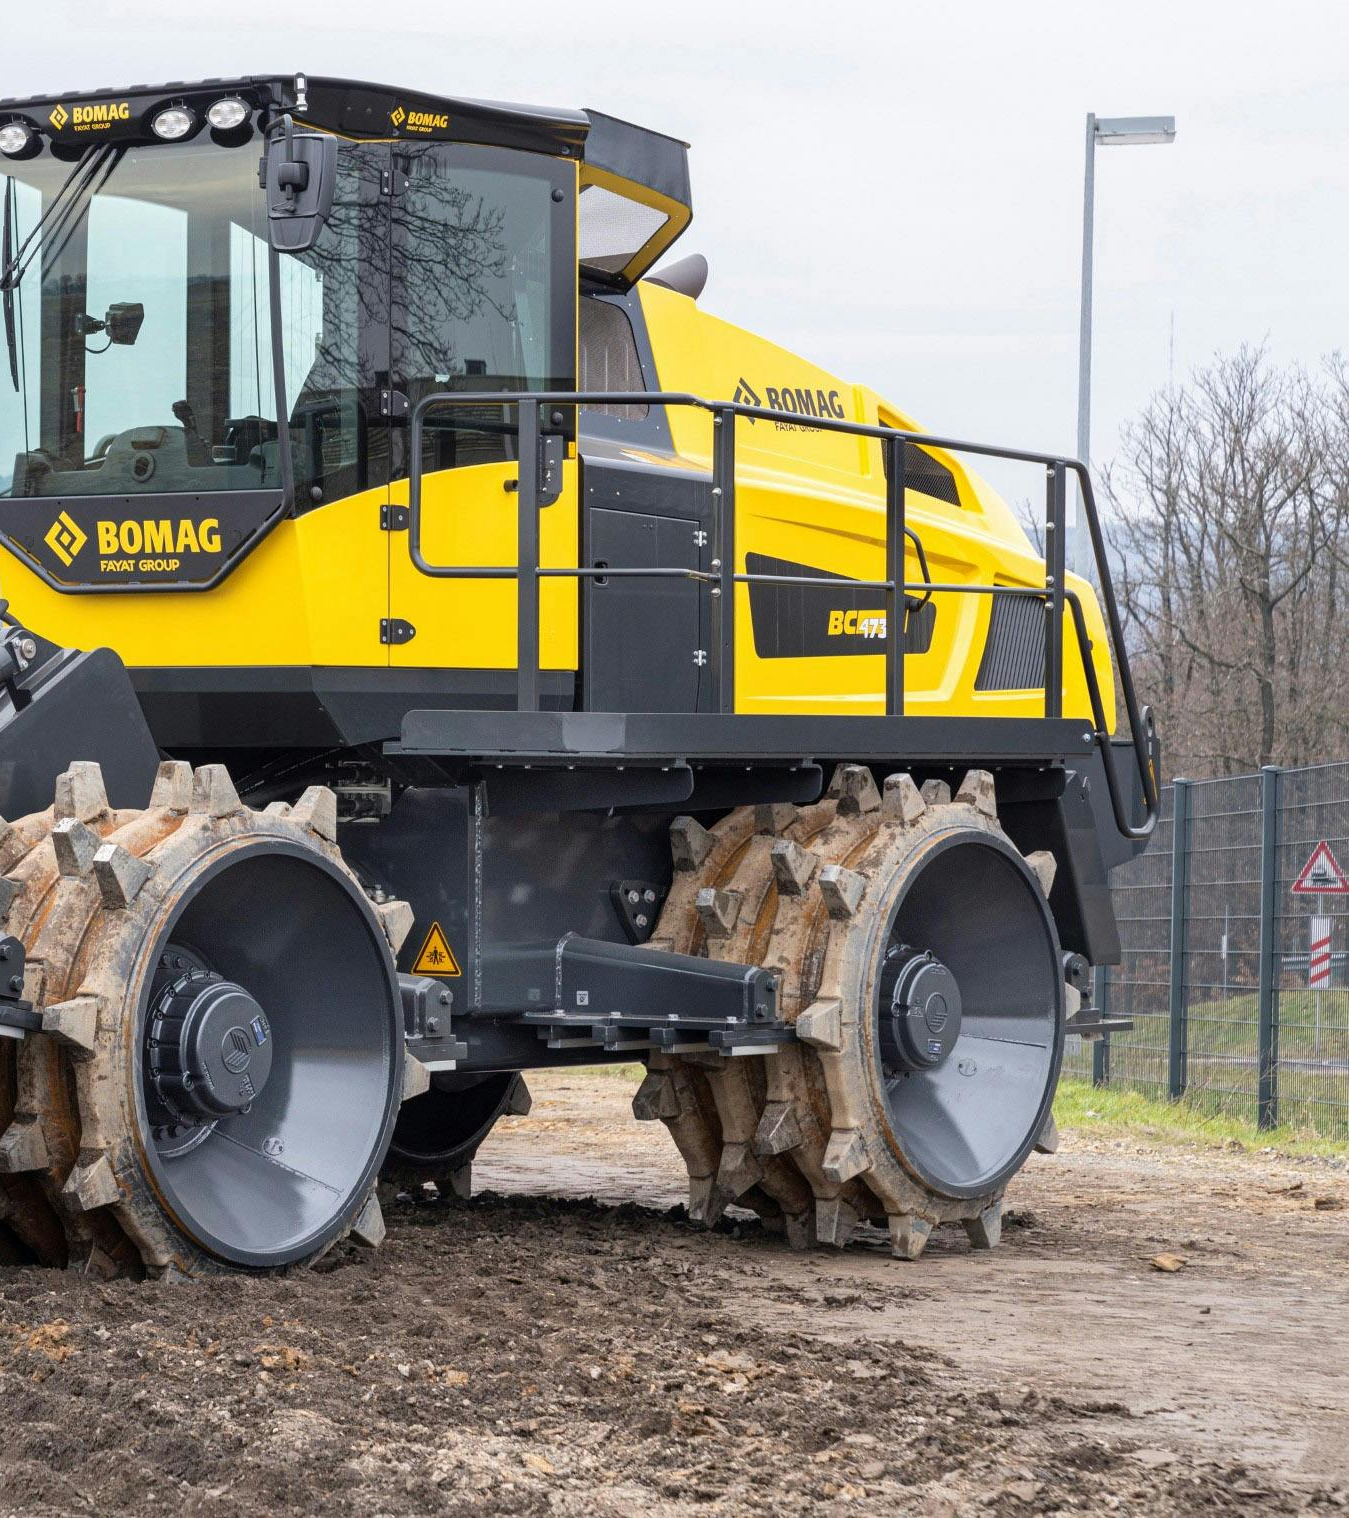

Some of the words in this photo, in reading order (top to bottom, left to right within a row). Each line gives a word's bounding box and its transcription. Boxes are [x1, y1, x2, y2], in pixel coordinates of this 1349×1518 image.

[73, 103, 129, 123] BOMAG
[408, 112, 448, 127] BOMAG
[766, 387, 844, 418] BOMAG
[96, 518, 222, 555] BOMAG
[100, 559, 135, 572] FAYAT
[139, 559, 180, 572] GROUP
